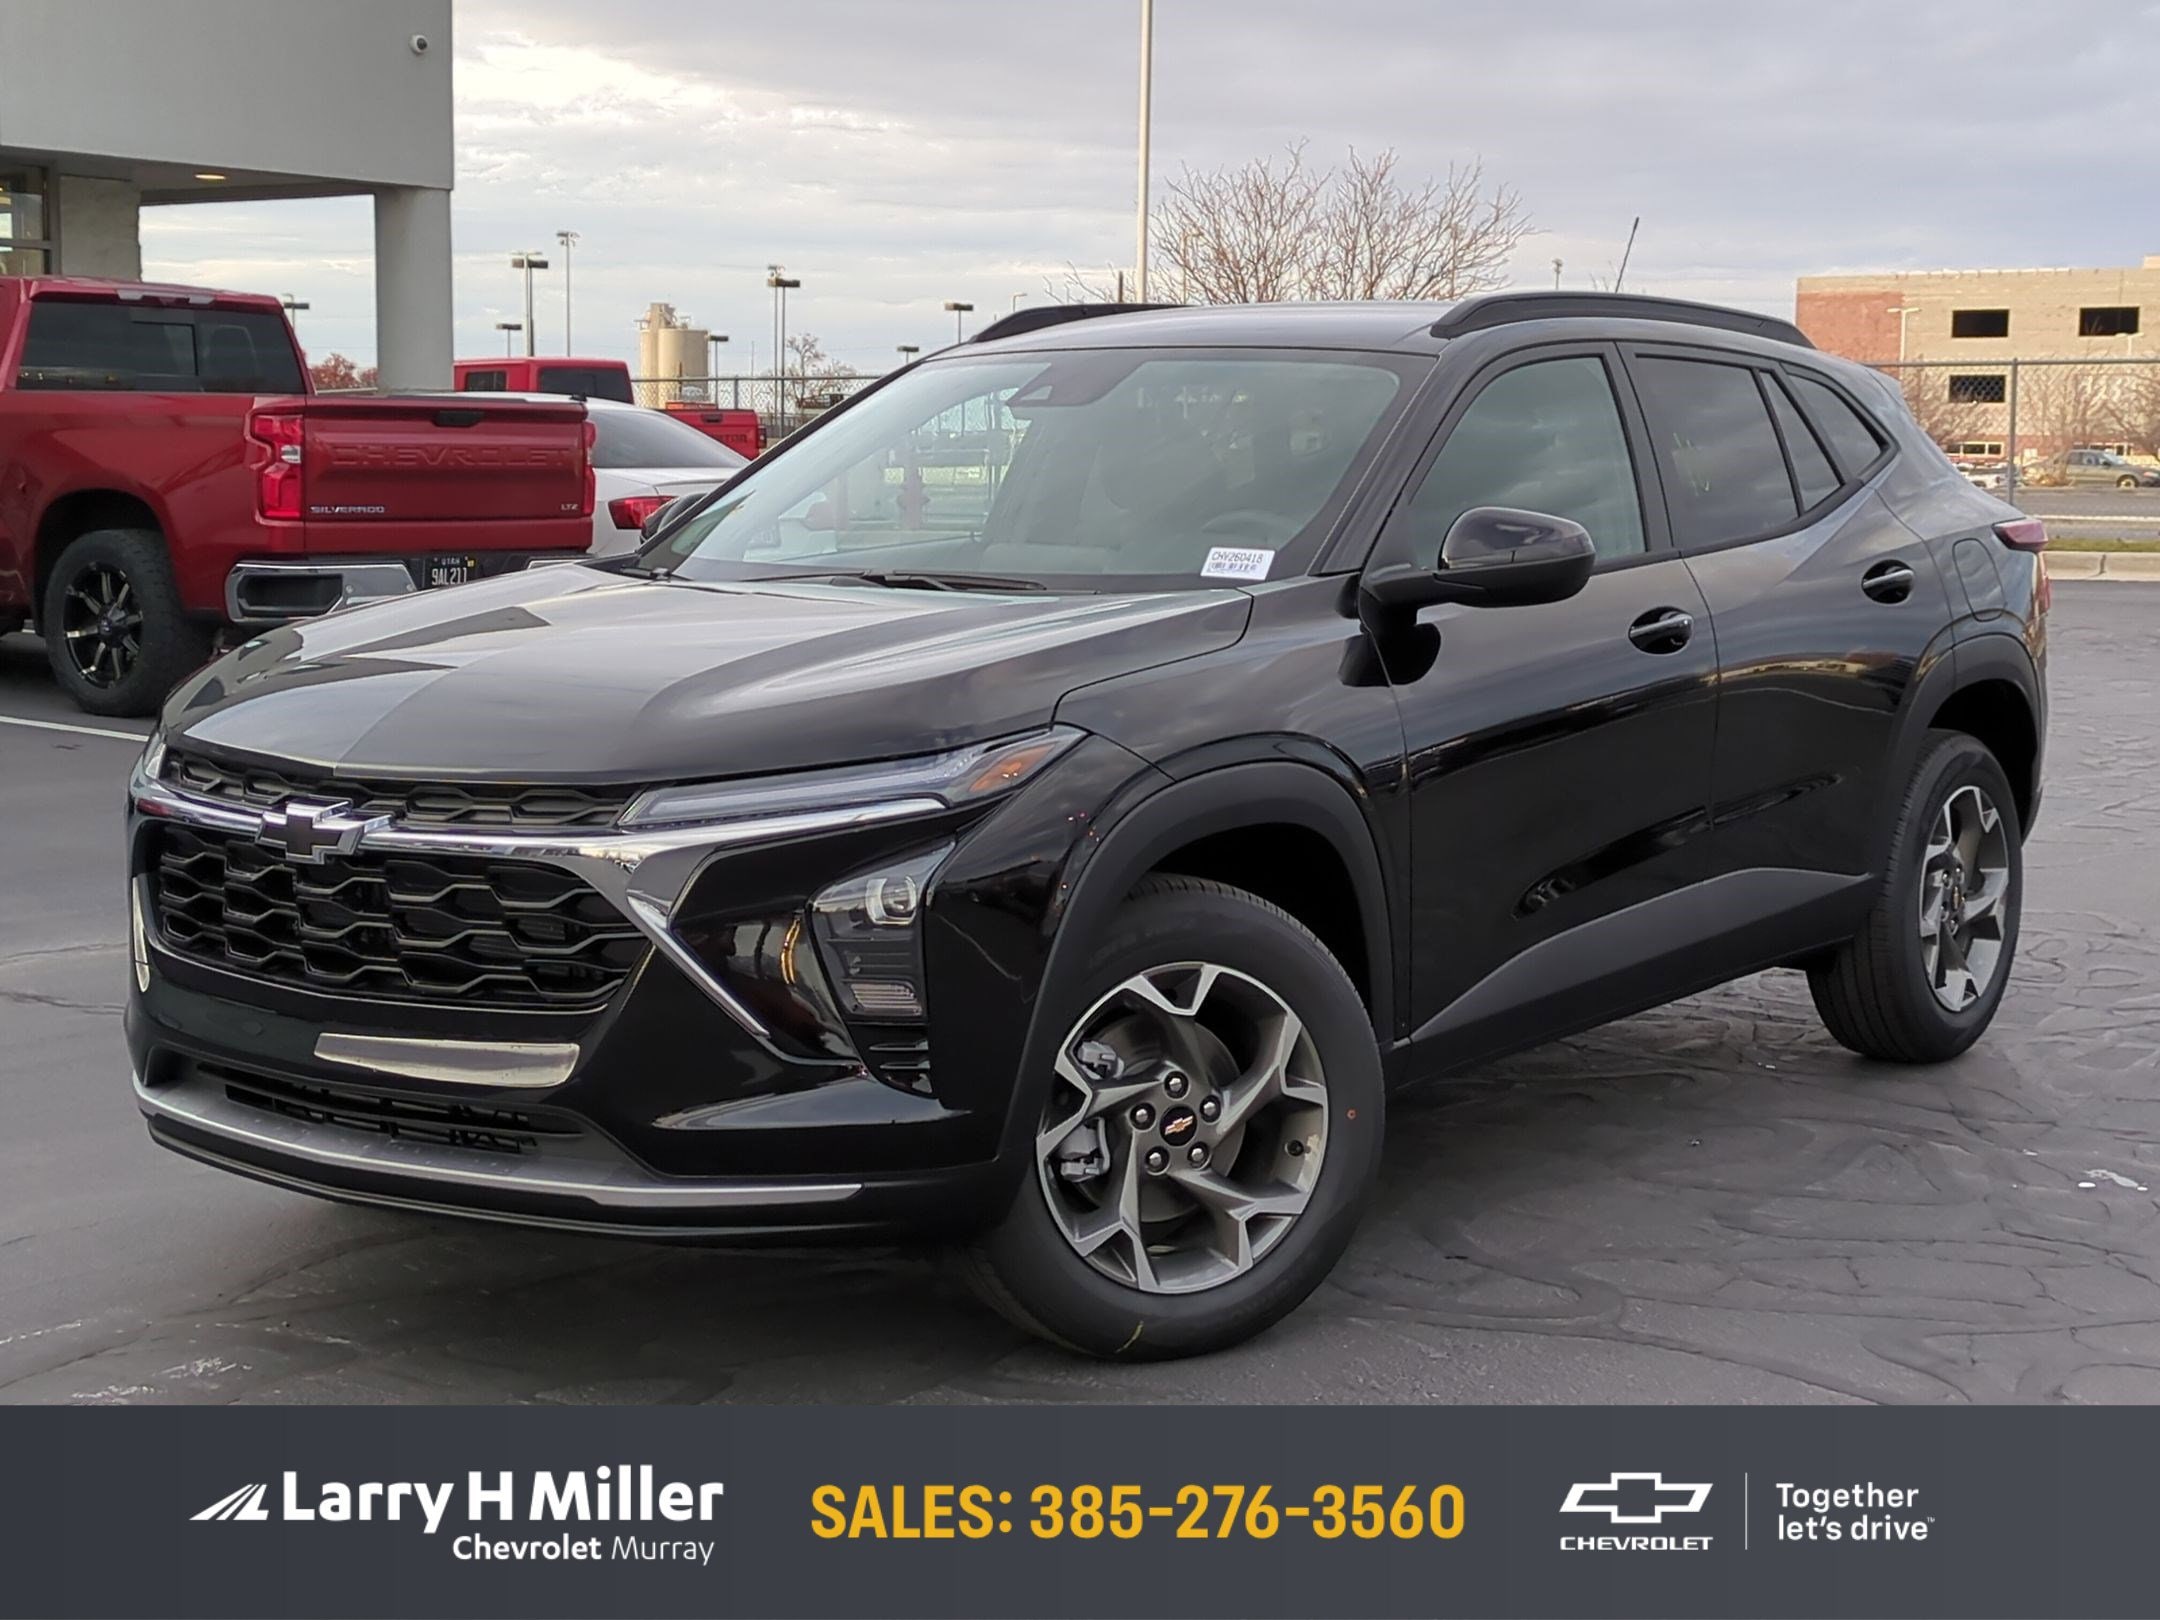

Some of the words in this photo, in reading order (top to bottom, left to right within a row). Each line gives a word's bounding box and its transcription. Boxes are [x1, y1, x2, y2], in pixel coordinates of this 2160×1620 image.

[332, 446, 574, 466] CHEVROLET
[310, 506, 385, 514] SILVERADO
[561, 503, 579, 511] LTZ
